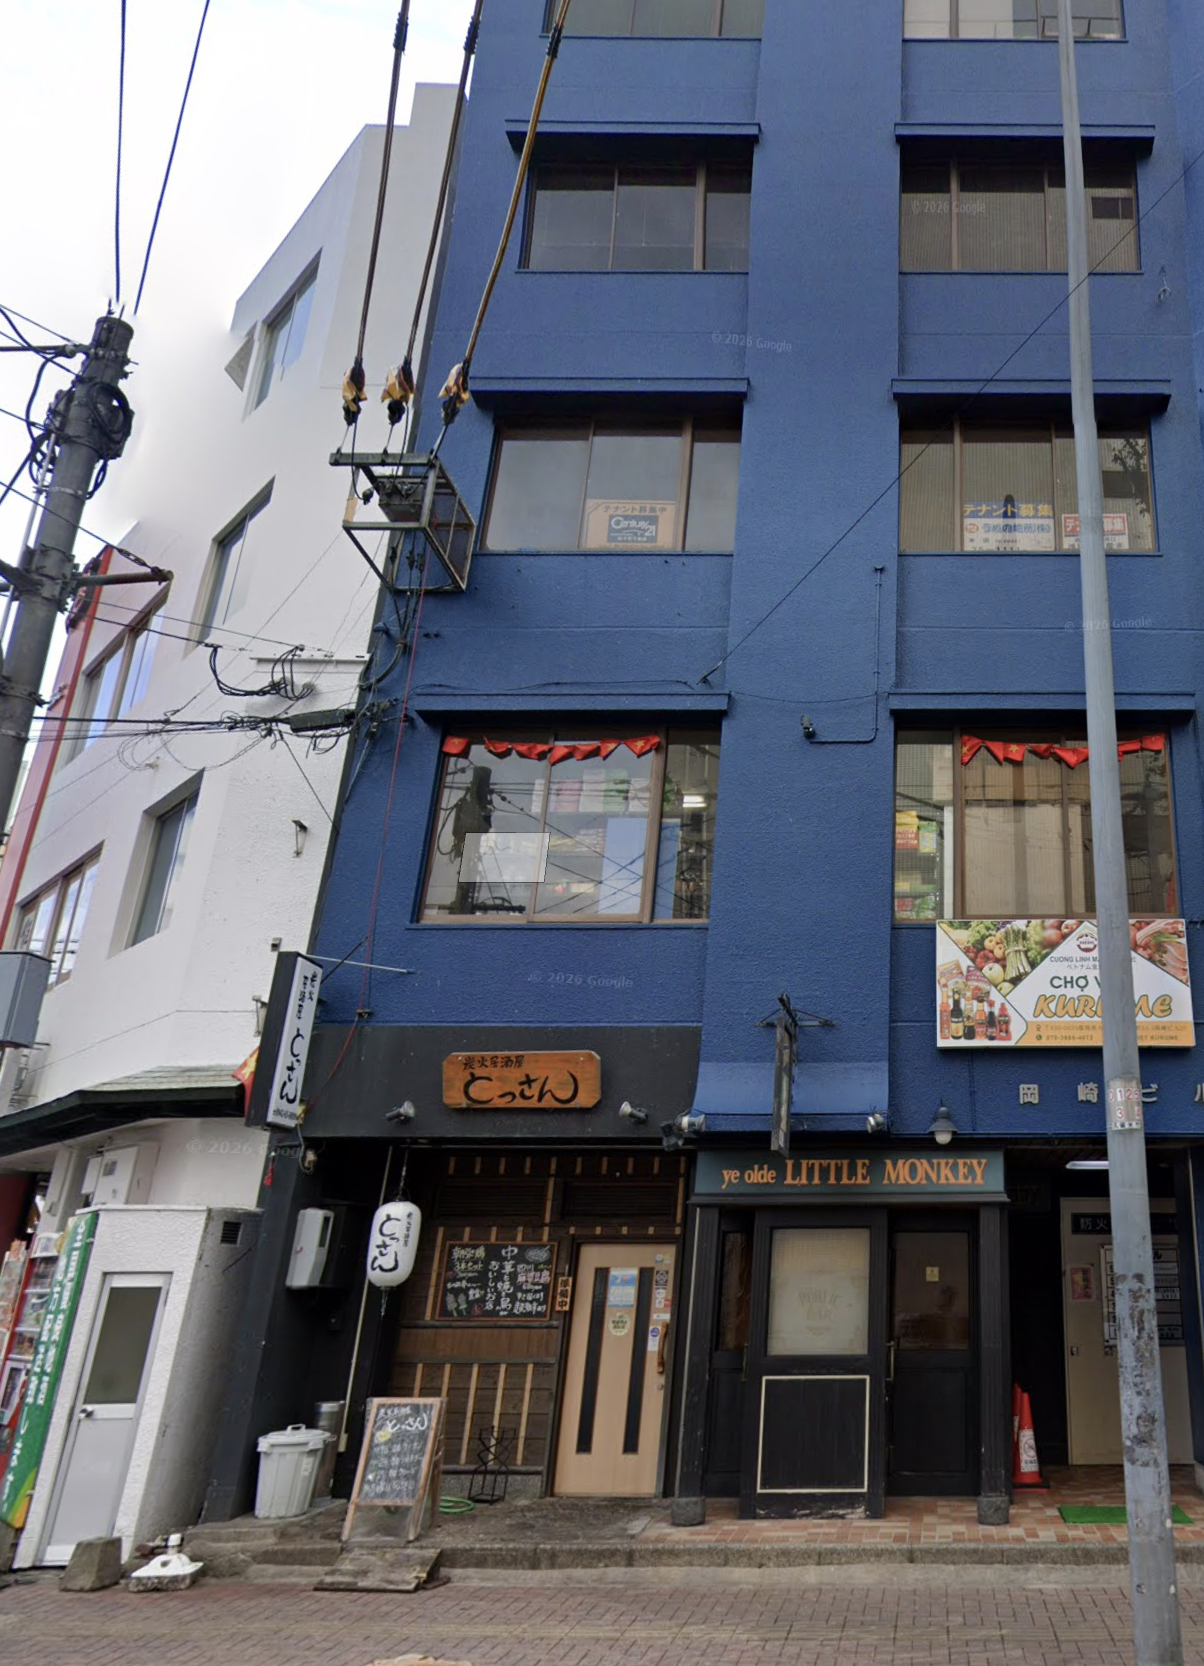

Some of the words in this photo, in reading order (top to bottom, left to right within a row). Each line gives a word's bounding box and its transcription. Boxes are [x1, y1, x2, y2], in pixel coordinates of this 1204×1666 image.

[603, 505, 667, 513] テナント募集中
[644, 525, 656, 536] 21
[1033, 994, 1172, 1019] KURME
[463, 1055, 525, 1070] 炭火居酒屋
[463, 1071, 579, 1105] とっさん
[721, 1168, 741, 1189] ye
[744, 1163, 776, 1185] olde
[784, 1160, 870, 1185] LITTLE
[883, 1159, 987, 1185] MONKEY
[370, 1214, 401, 1273] とっさん
